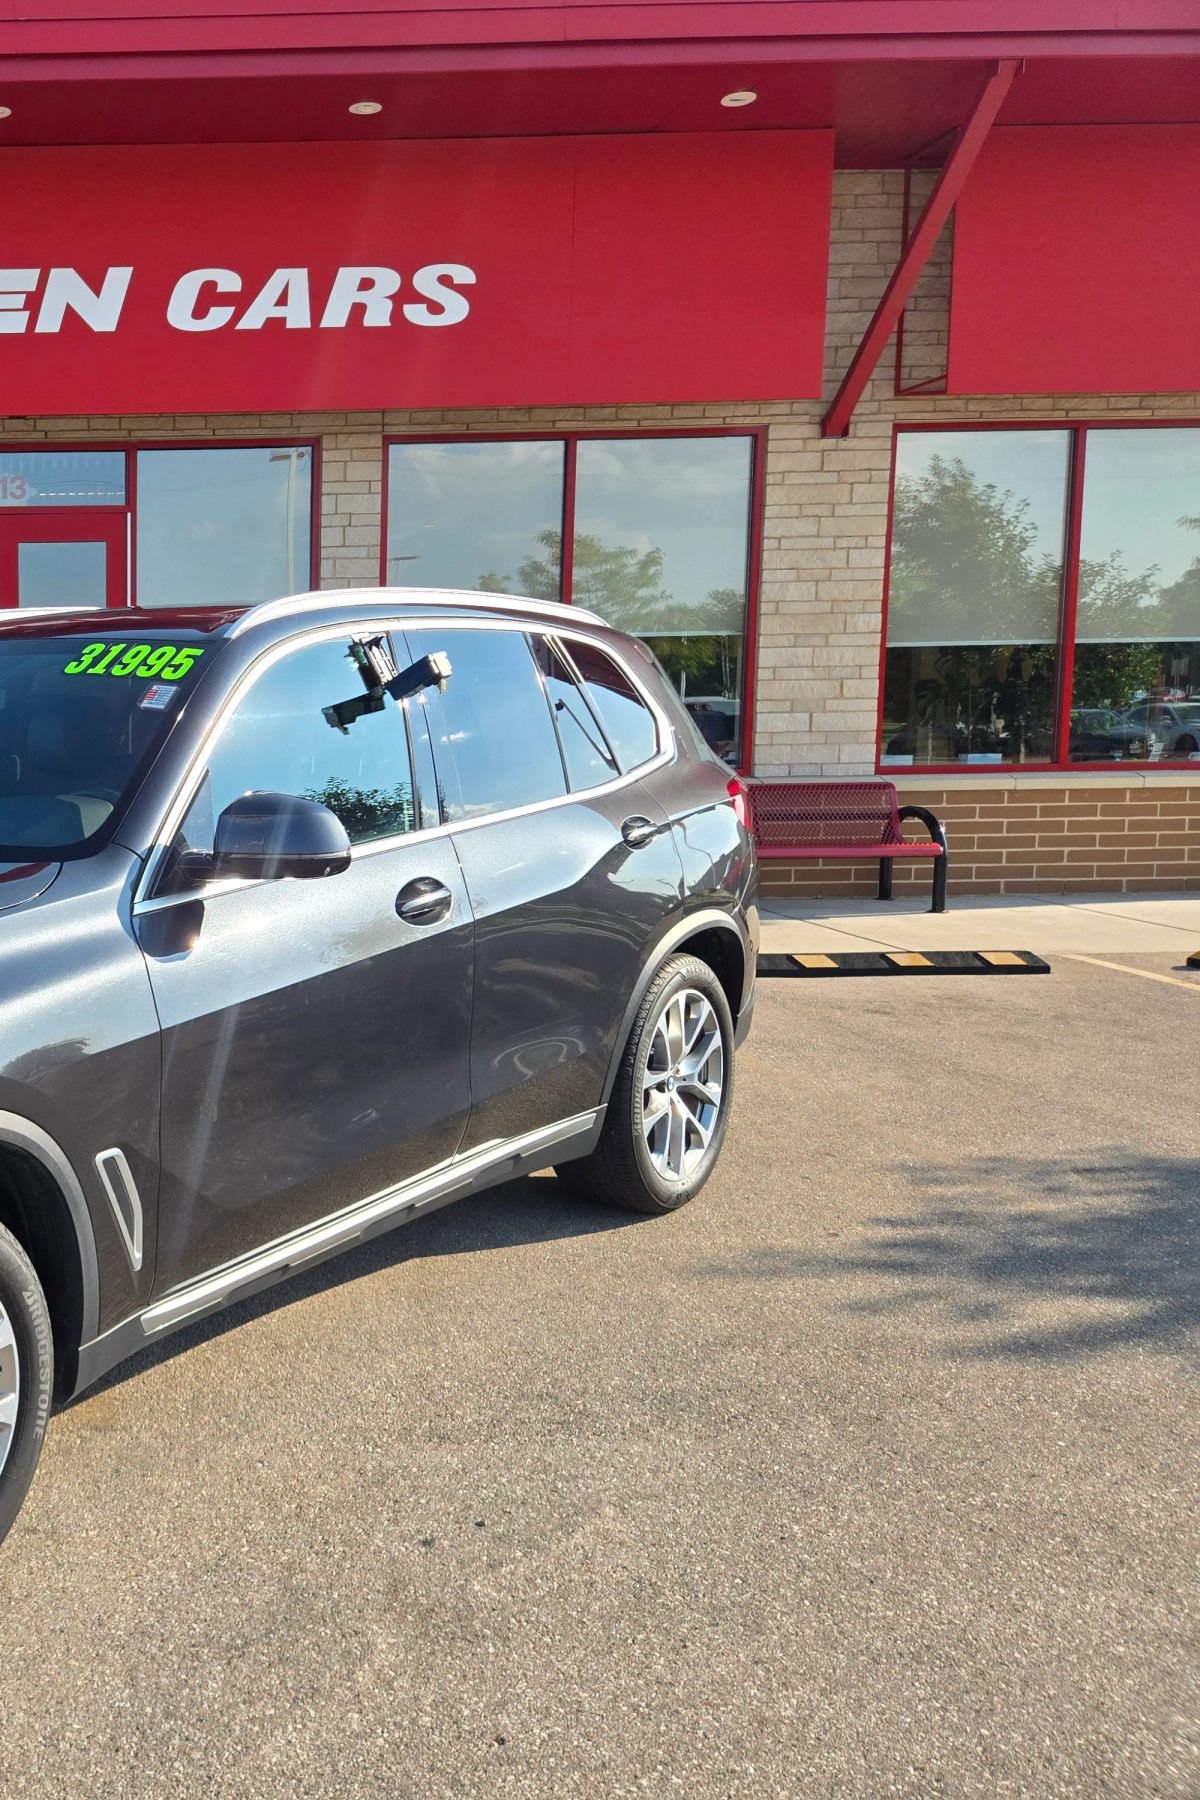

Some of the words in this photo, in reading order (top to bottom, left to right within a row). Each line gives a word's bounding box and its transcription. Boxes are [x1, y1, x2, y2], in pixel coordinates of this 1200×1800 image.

[167, 263, 477, 332] CARS
[64, 643, 204, 680] 31995
[22, 1286, 49, 1440] BRIDGESTONE
